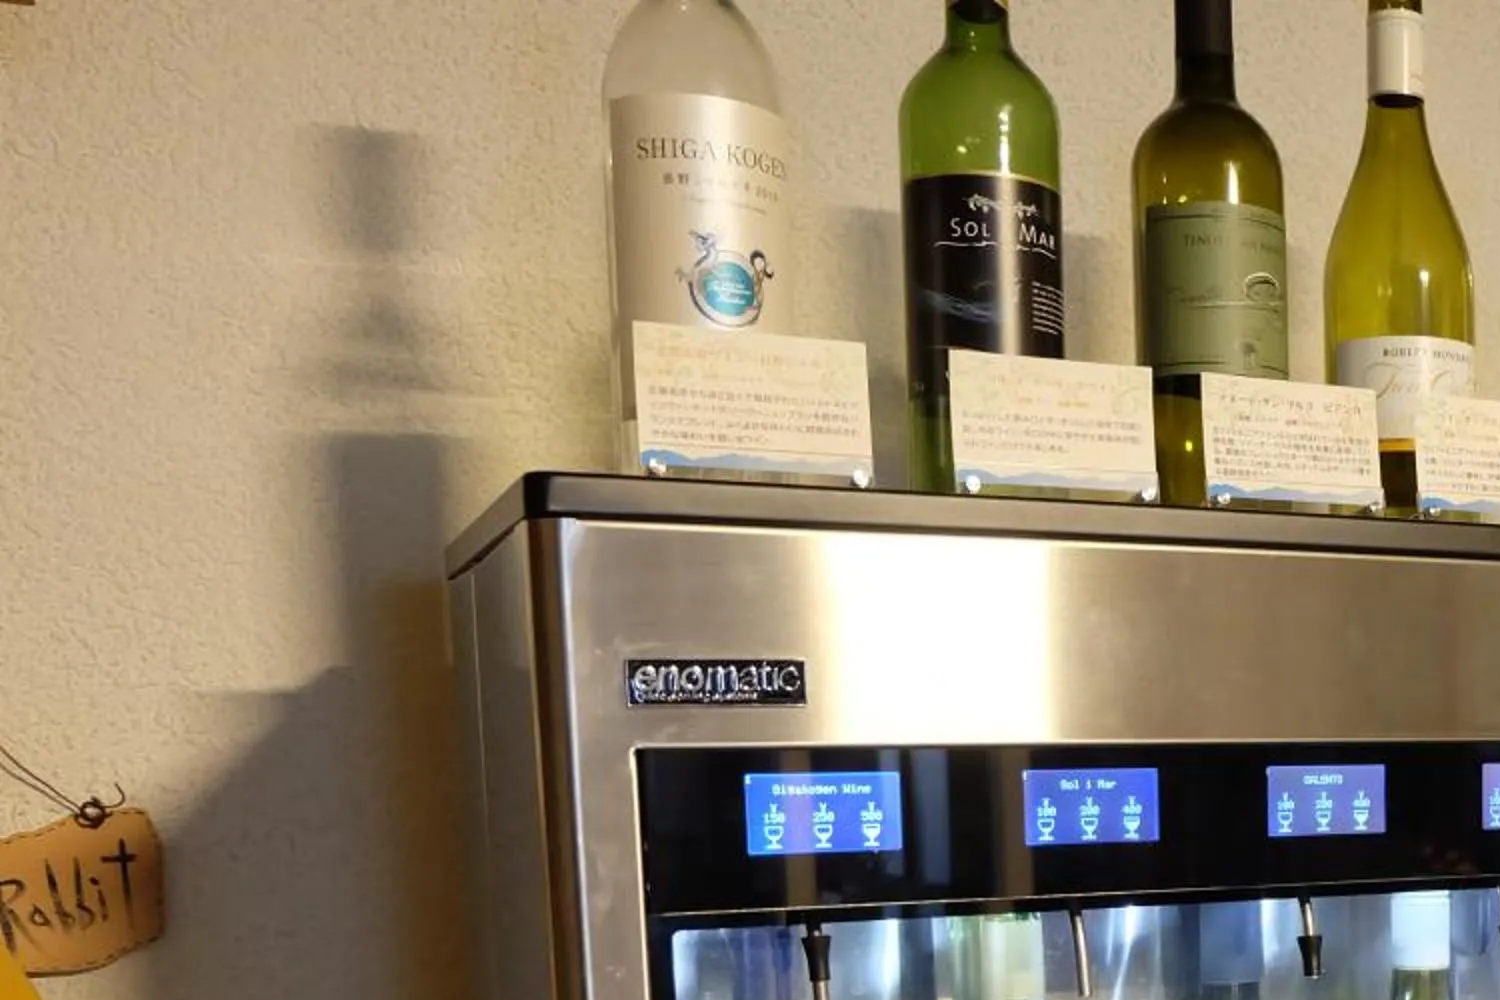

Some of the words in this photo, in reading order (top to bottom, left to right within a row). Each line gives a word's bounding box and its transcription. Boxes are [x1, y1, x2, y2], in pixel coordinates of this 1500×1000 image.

[636, 136, 717, 161] SHIGA
[950, 217, 991, 237] SOL
[633, 661, 801, 692] enomatic
[0, 838, 138, 957] Rabbit
